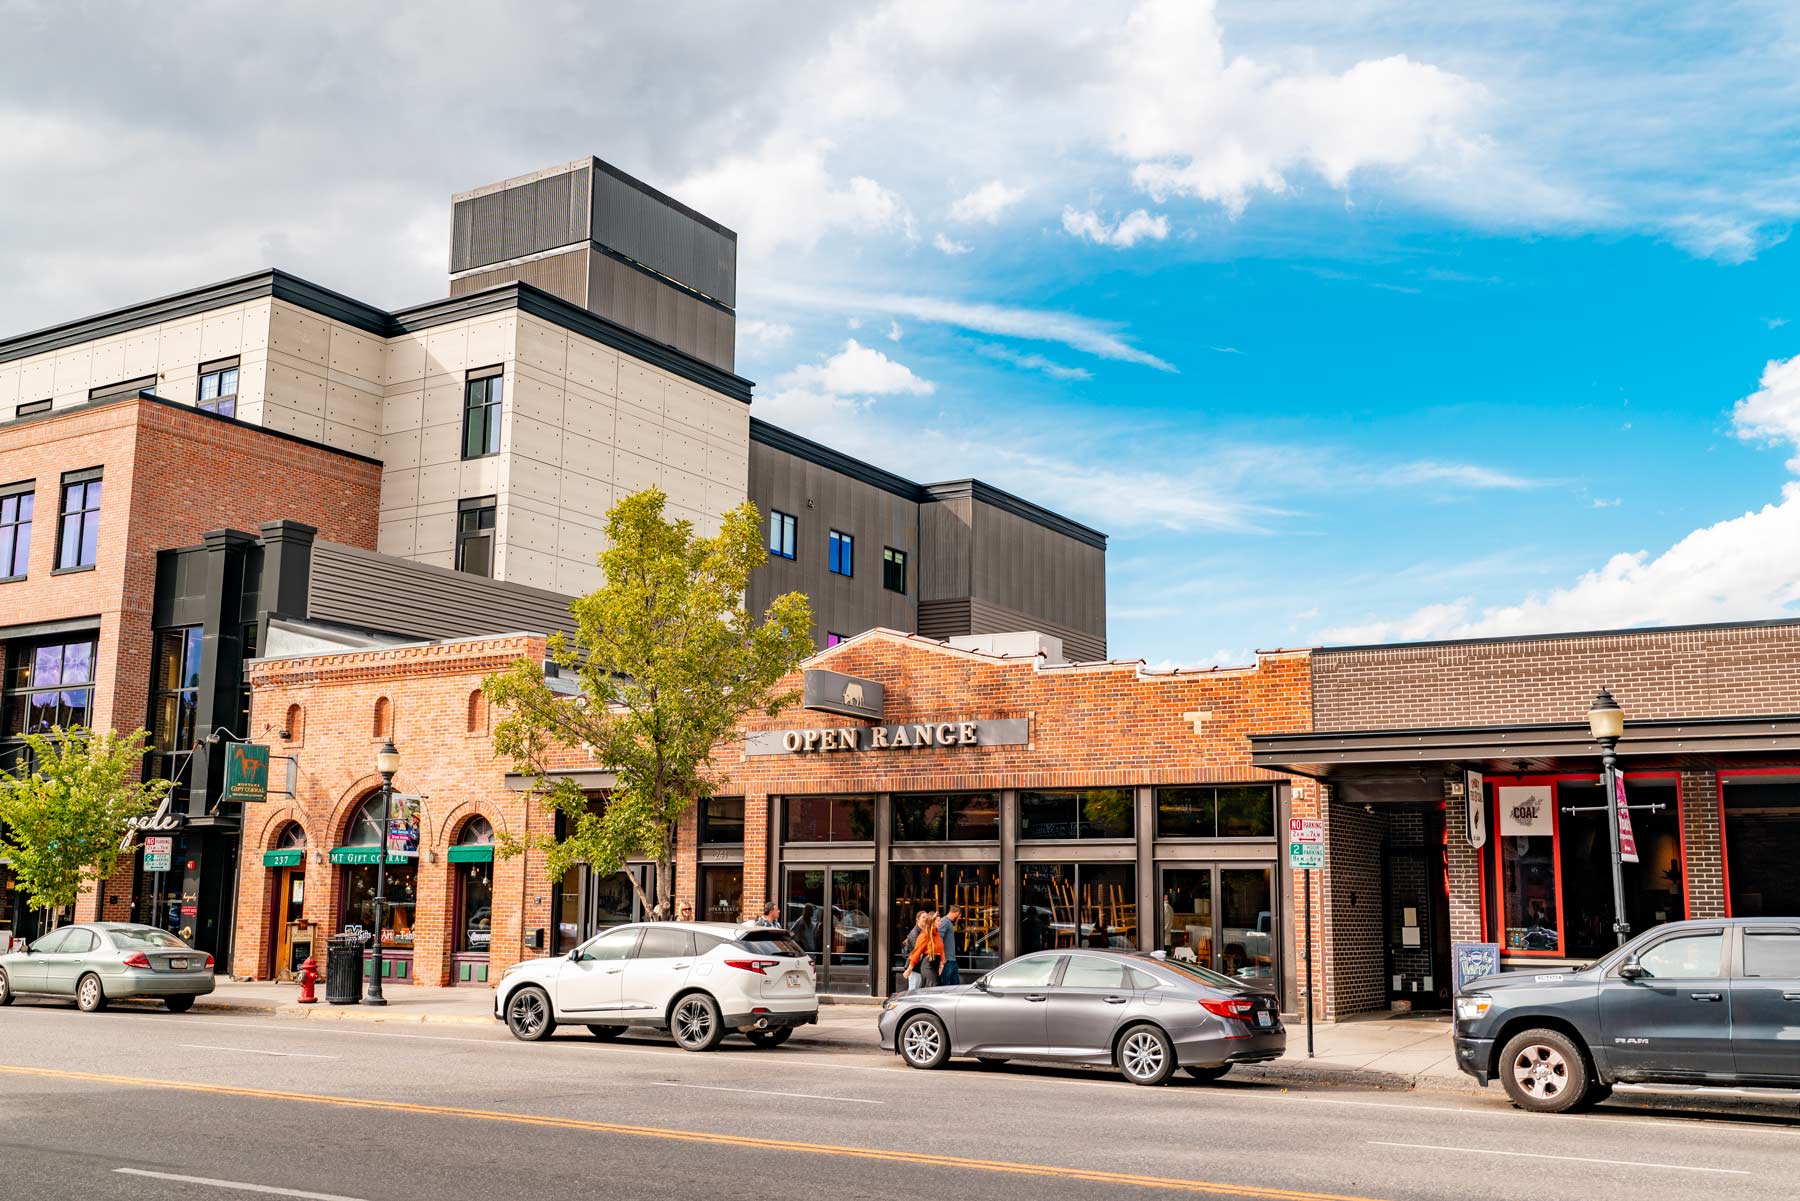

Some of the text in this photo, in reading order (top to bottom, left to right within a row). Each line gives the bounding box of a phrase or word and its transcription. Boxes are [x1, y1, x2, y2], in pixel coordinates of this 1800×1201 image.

[783, 721, 978, 752] OPEN RANGE
[1513, 806, 1538, 819] COAL
[1292, 820, 1301, 829] NO
[1294, 845, 1300, 854] 2
[331, 853, 344, 863] MT
[714, 850, 728, 860] 241
[274, 856, 289, 865] 237
